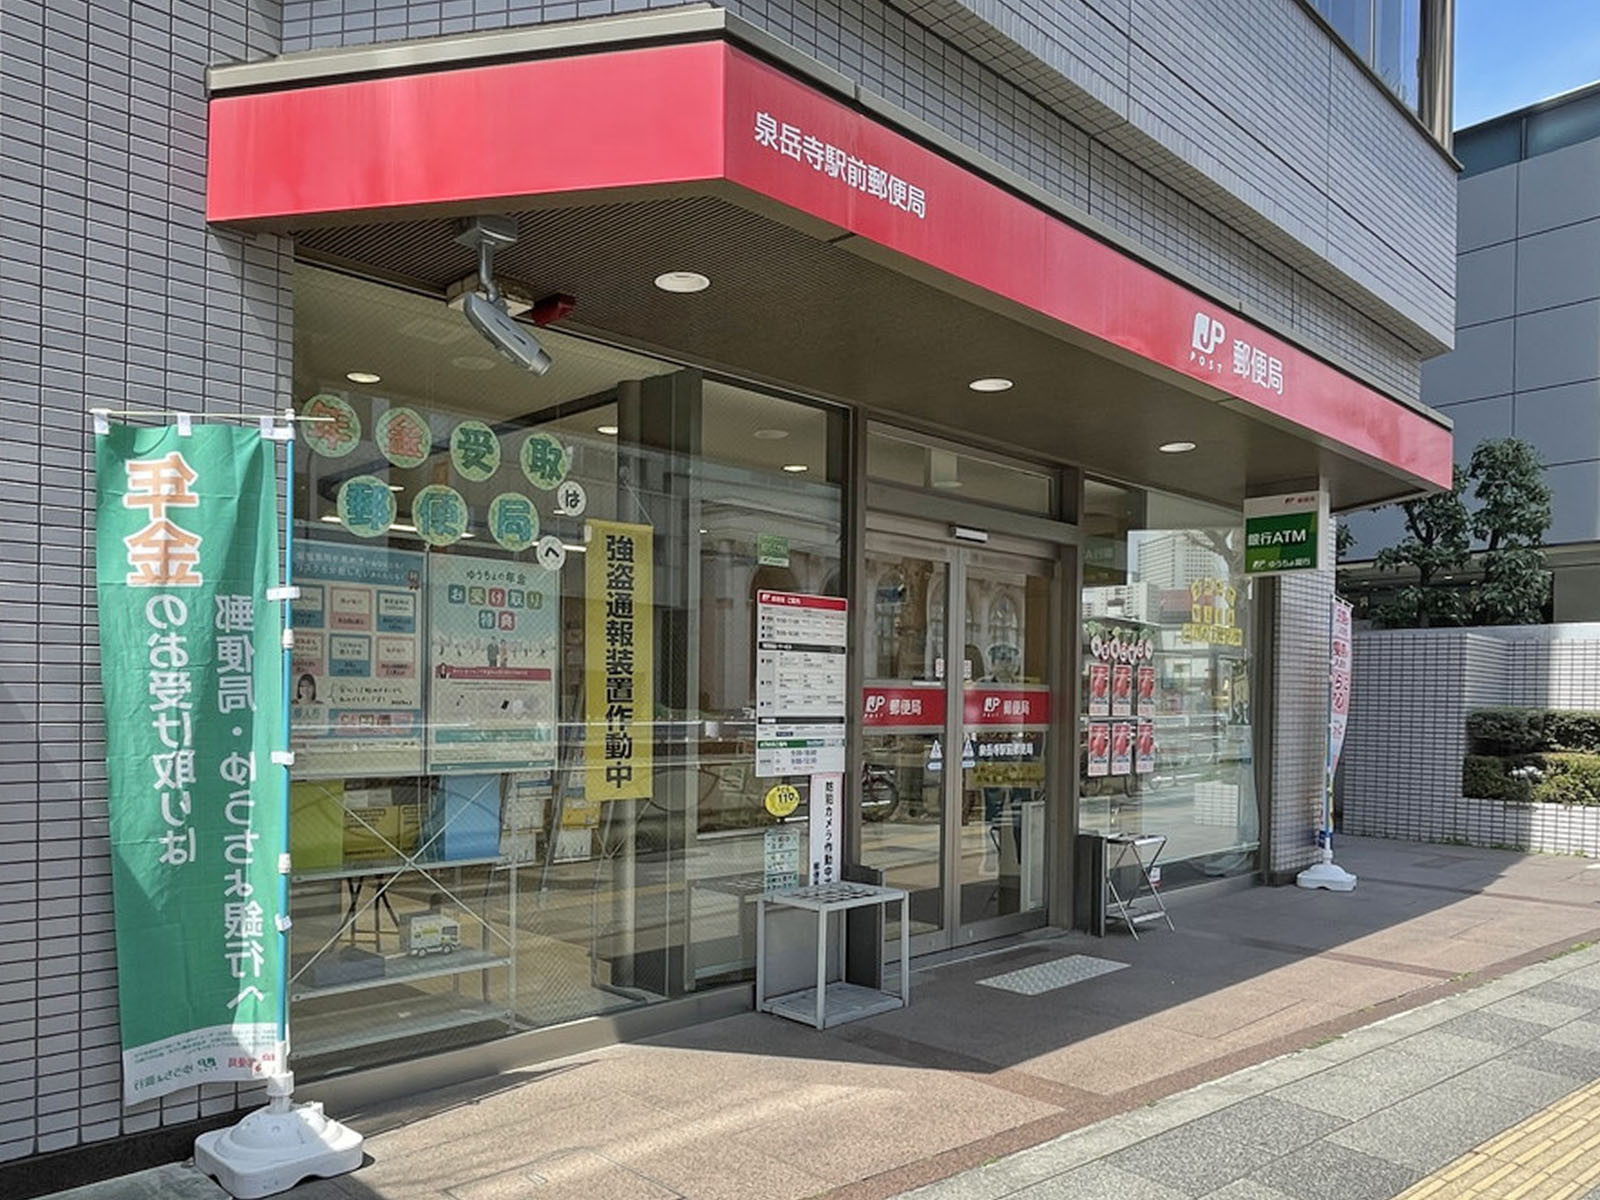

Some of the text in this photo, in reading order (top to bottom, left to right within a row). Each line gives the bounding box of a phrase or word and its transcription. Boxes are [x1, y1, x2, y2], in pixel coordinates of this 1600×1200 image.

[754, 112, 926, 219] 泉岳寺駅前郵便局
[1233, 340, 1283, 395] 郵便局
[605, 534, 634, 788] 強盗通報装置作動中
[889, 699, 921, 715] 郵便局
